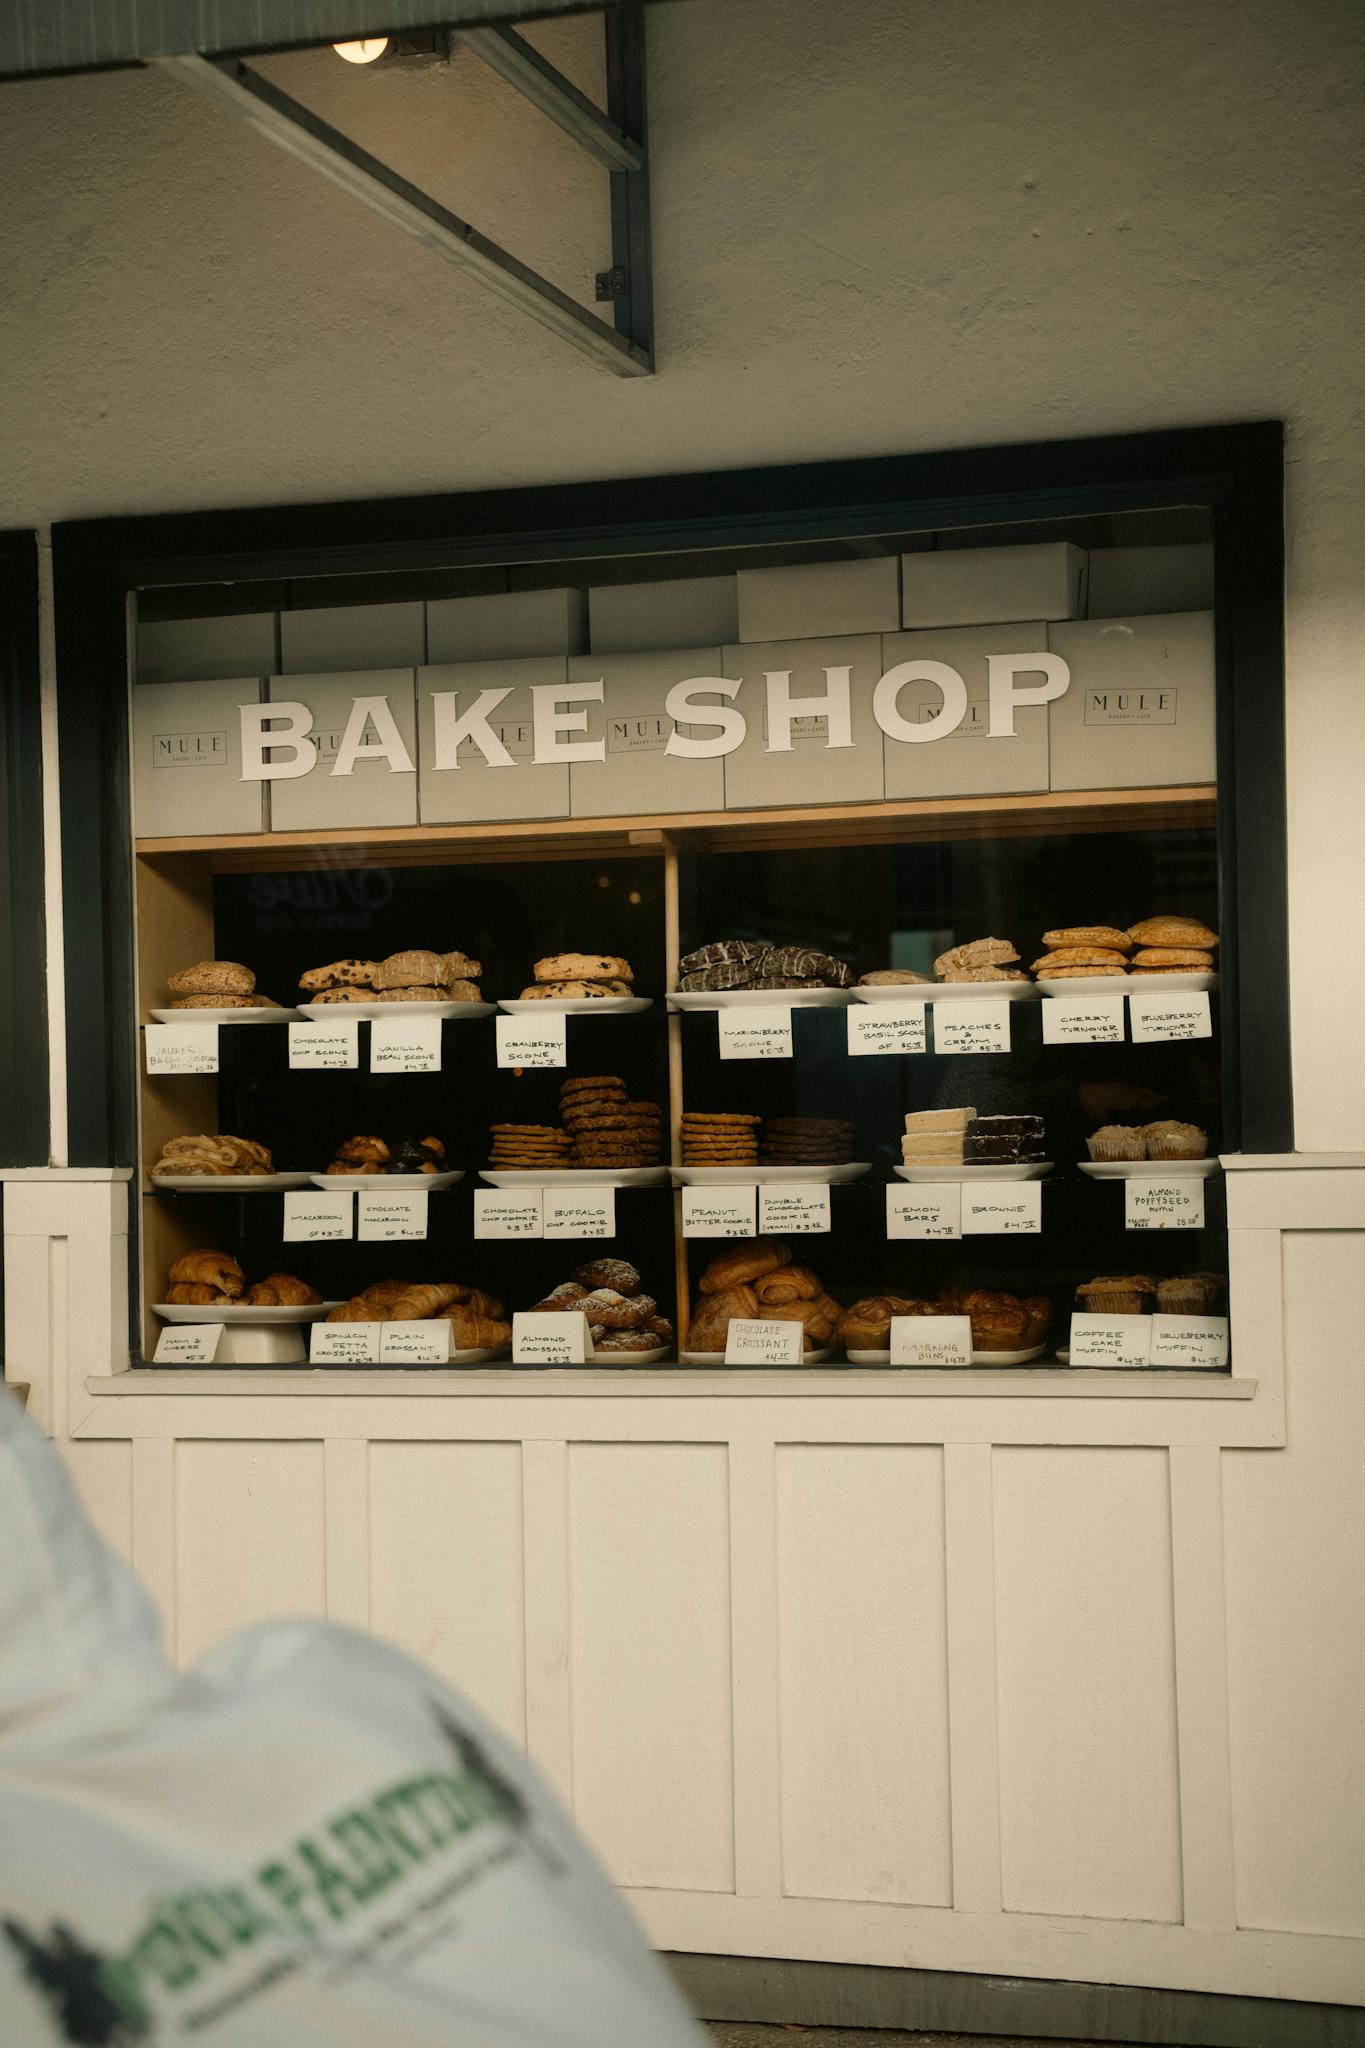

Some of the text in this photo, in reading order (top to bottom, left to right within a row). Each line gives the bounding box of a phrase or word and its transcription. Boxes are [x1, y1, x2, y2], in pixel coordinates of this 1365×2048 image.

[1093, 694, 1169, 710] MULE
[238, 652, 1071, 782] BAKE SHOP
[614, 720, 683, 738] MULE
[160, 737, 221, 754] MULE
[310, 733, 377, 749] MUE
[1142, 1012, 1202, 1021] BLUEBERRY
[858, 1019, 922, 1030] STRAWBERRY
[1143, 1024, 1196, 1032] TURNOVER
[864, 1031, 894, 1039] BASIL
[505, 1041, 563, 1049] CRANBERRY
[508, 1052, 549, 1060] SCONE
[1135, 1197, 1189, 1205] POPPYSEED
[972, 1206, 1025, 1214] BROWNIE
[736, 1324, 781, 1334] CHOCOLATE
[737, 1337, 789, 1348] CROISSANT
[902, 1344, 958, 1352] MORNING
